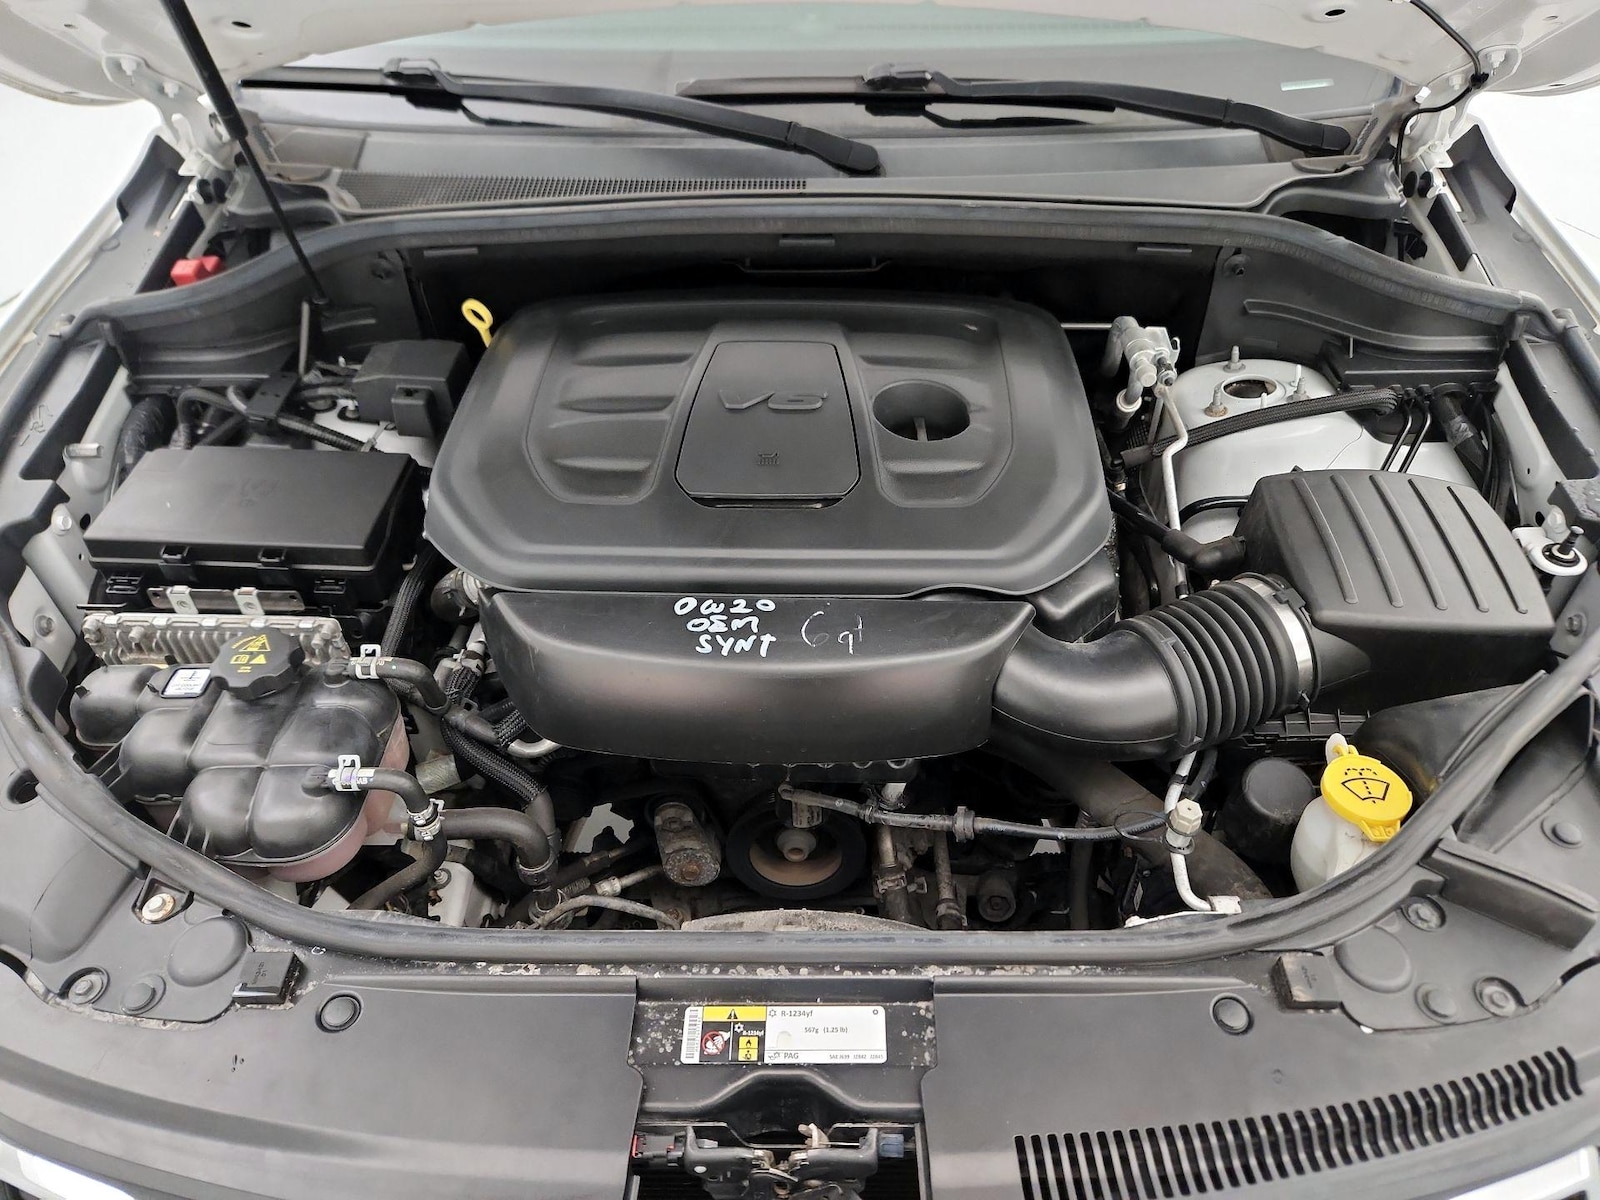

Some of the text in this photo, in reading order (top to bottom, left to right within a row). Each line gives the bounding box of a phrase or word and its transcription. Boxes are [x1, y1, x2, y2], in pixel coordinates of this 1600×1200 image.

[686, 614, 760, 633] OEM
[781, 1010, 813, 1018] R-1234yf
[839, 1026, 848, 1034] lb)
